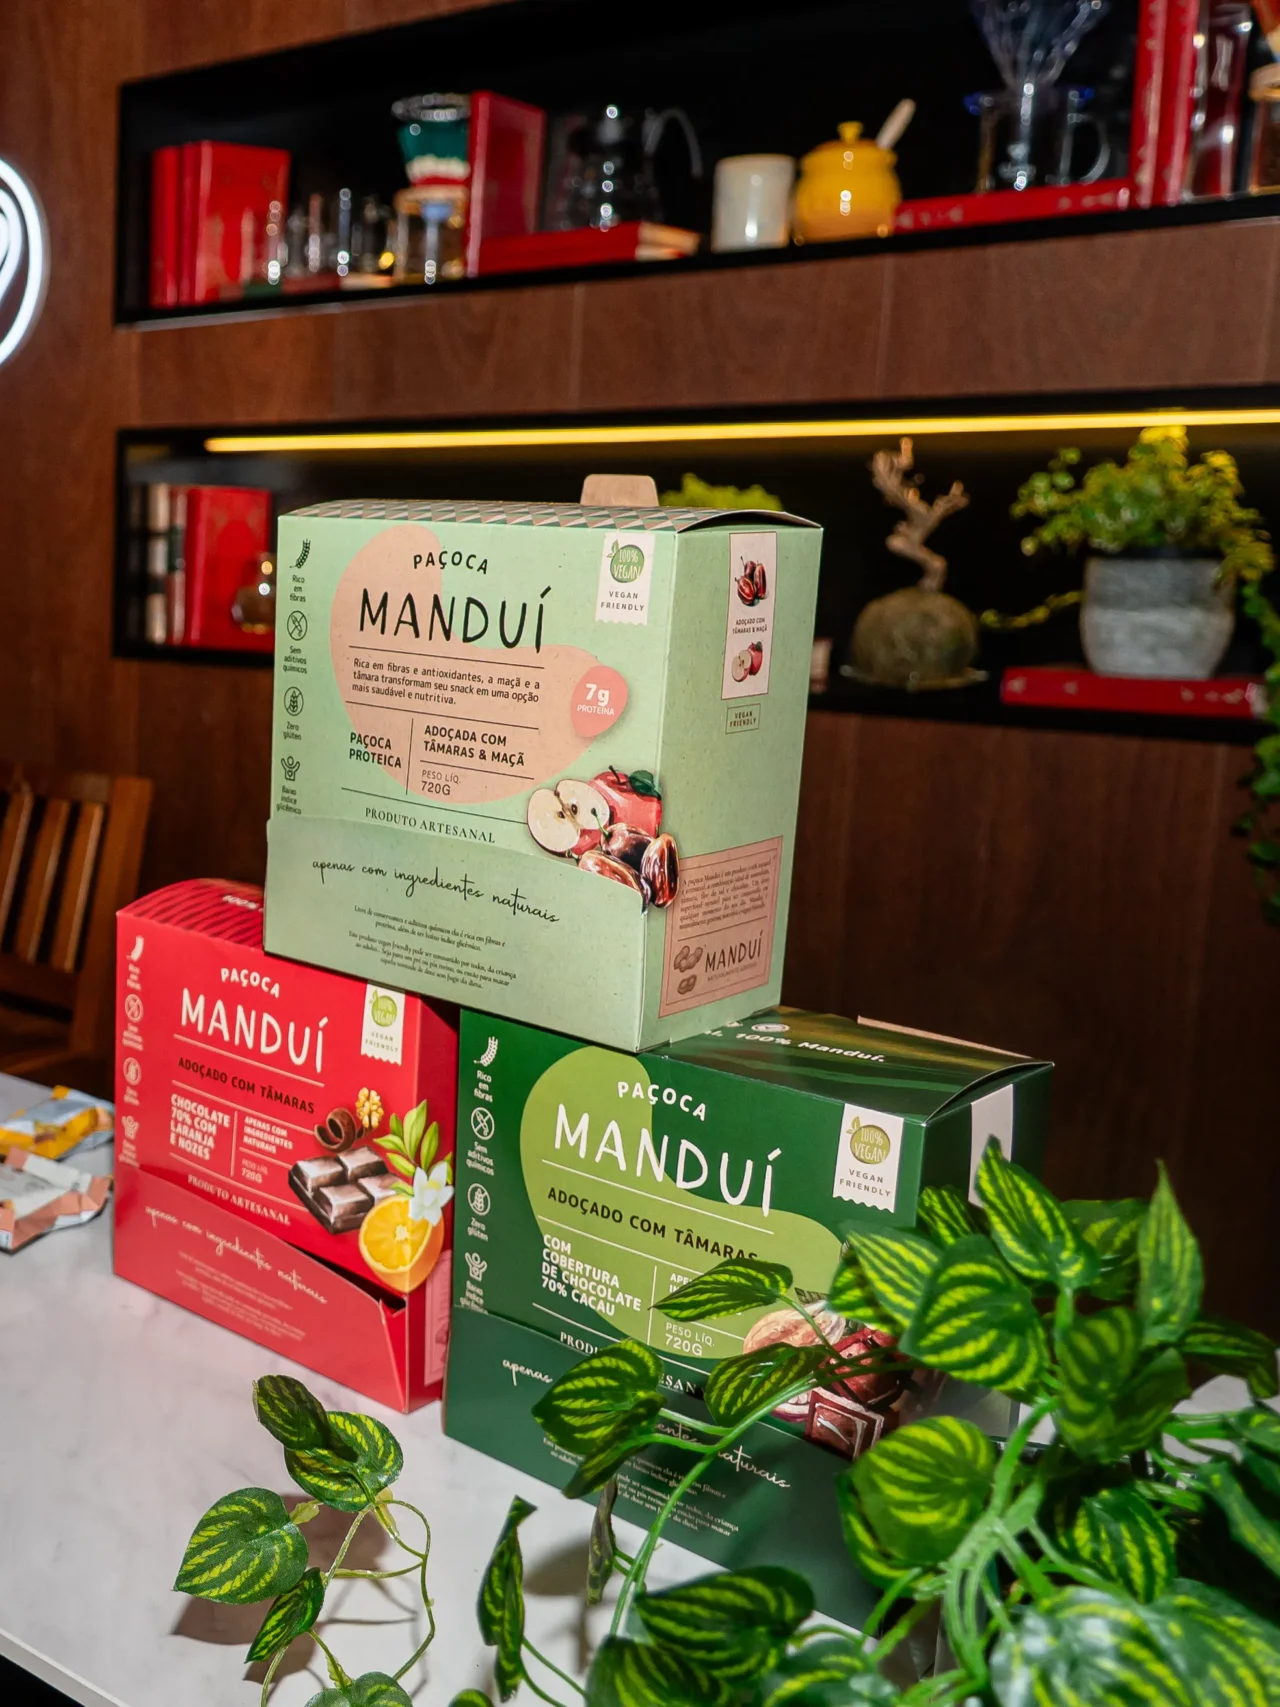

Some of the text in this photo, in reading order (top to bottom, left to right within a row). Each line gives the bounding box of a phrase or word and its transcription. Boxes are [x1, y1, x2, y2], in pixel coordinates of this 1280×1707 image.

[413, 550, 488, 575] PAÇOCA
[619, 549, 639, 563] 100%
[292, 574, 305, 584] Rico
[613, 564, 641, 579] VEGAN
[289, 592, 306, 603] fibras
[600, 601, 645, 611] FRIENDLY
[609, 590, 639, 599] VEGAN
[360, 585, 551, 654] MANDUÍ
[283, 654, 307, 665] aditivos
[289, 645, 302, 655] Sem
[353, 658, 540, 690] Rica em fibras e antioxidantes, a maçã e a
[352, 682, 457, 705] mais saudável e nutritiva.
[353, 670, 540, 704] tâmara transformam seu snack em uma opção
[585, 683, 610, 707] 7g
[282, 730, 302, 741] glúten
[286, 721, 300, 731] Zero
[424, 724, 507, 747] ADOÇADA COM
[350, 731, 392, 750] PAÇOCA
[349, 748, 402, 769] PROTEICA
[423, 740, 525, 767] TÂMARAS & MAÇÃ
[421, 769, 462, 785] PESO LÍQ.
[421, 781, 451, 796] 720G
[365, 807, 496, 844] PRODUTO ARTESANAL
[312, 859, 560, 923] apenas com ingredientes naturais
[704, 929, 764, 973] MANDUÍ
[220, 967, 280, 999] PAÇOCA
[180, 987, 329, 1074] MANDUÍ
[371, 1031, 394, 1042] VEGAN
[735, 1033, 791, 1046] 100%
[798, 1041, 885, 1063] Manduí.
[178, 1056, 315, 1115] ADOÇADO COM TÂMARAS
[476, 1069, 493, 1084] Rico
[478, 1081, 490, 1092] em
[473, 1087, 494, 1104] fibras
[617, 1081, 706, 1121] PAÇOCA
[171, 1093, 231, 1128] CHOCOLATE
[171, 1106, 217, 1136] 70% COM
[170, 1119, 215, 1150] LARANJA
[243, 1125, 293, 1150] INGREDIENTES
[244, 1115, 288, 1138] APENAS COM
[860, 1127, 884, 1146] 100%
[169, 1132, 210, 1161] E NOZES
[243, 1135, 277, 1155] NATURAIS
[473, 1140, 488, 1154] Sem
[854, 1142, 886, 1163] VEGAN
[467, 1148, 494, 1167] aditivos
[554, 1103, 782, 1218] MANDUÍ
[839, 1178, 891, 1197] FRIENDLY
[848, 1168, 883, 1184] VEGAN
[187, 1174, 291, 1227] PRODUTO ARTESANAL
[547, 1186, 623, 1225] ADOÇADO
[629, 1215, 666, 1238] COM
[467, 1225, 489, 1242] glúten
[470, 1216, 486, 1231] Zero
[543, 1234, 572, 1254] COM
[542, 1248, 620, 1289] COBERTURA
[670, 1272, 694, 1287] APE
[541, 1261, 642, 1312] DE CHOCOLATE
[541, 1275, 615, 1317] 70% CACAU
[559, 1330, 600, 1355] PROD
[665, 1321, 715, 1348] PESO LÍQ.
[665, 1332, 703, 1357] 720G
[501, 1358, 554, 1387] apenas
